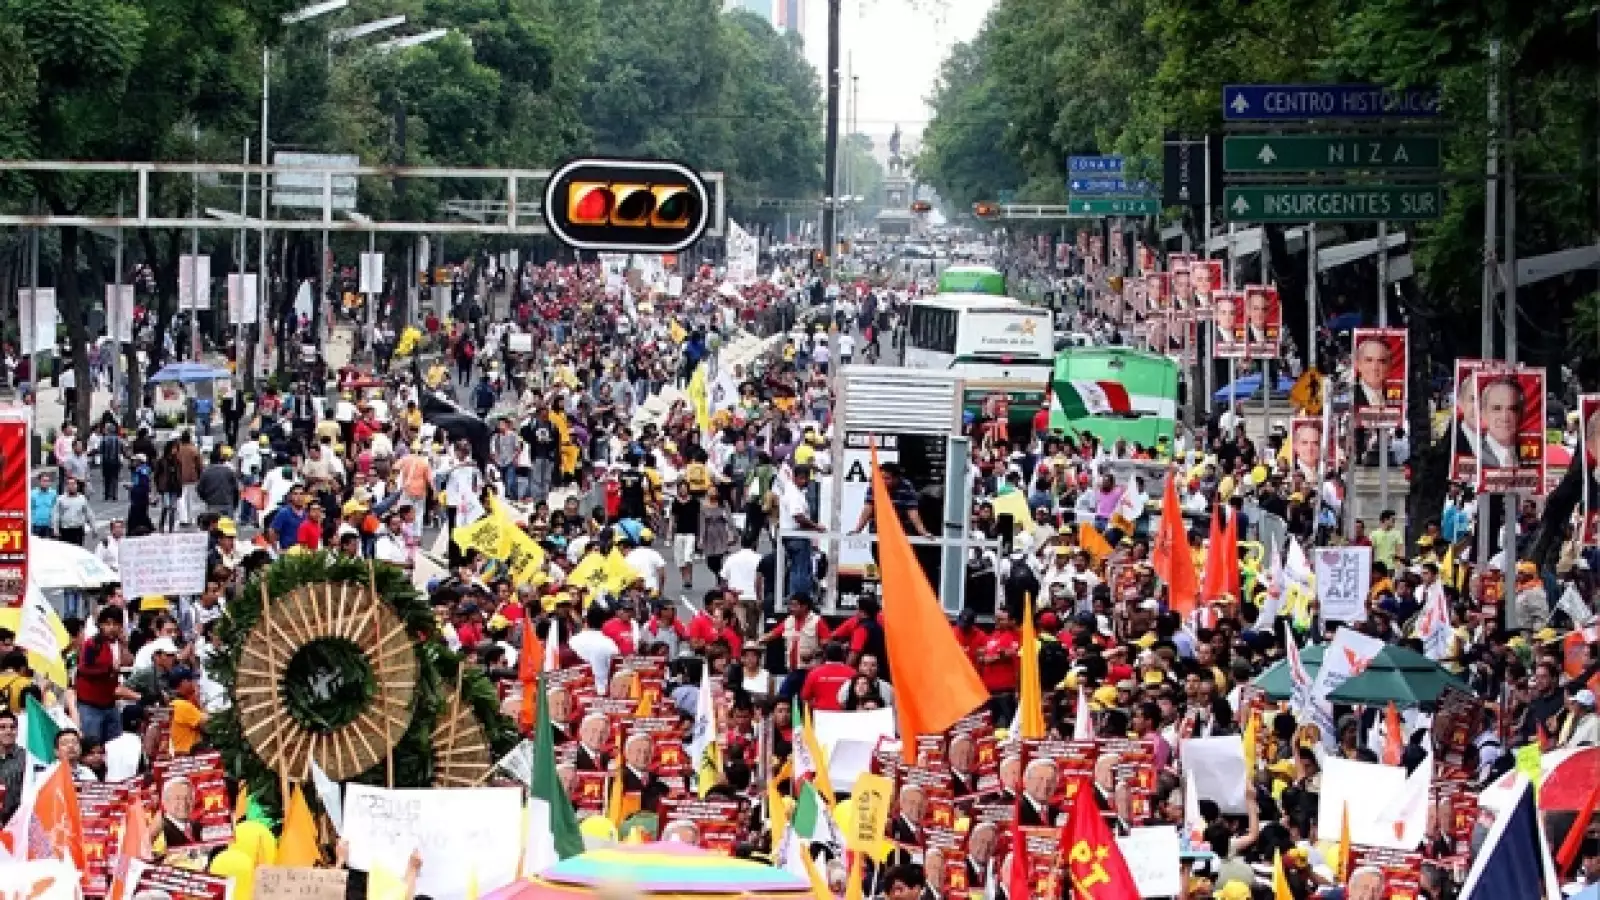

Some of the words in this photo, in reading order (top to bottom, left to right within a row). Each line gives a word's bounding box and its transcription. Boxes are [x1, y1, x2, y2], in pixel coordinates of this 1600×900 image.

[1263, 91, 1334, 114] CENTRO
[1328, 142, 1409, 164] NIZA
[1263, 193, 1391, 215] INSURGENTES
[1402, 193, 1435, 215] SUR
[0, 529, 24, 550] PT
